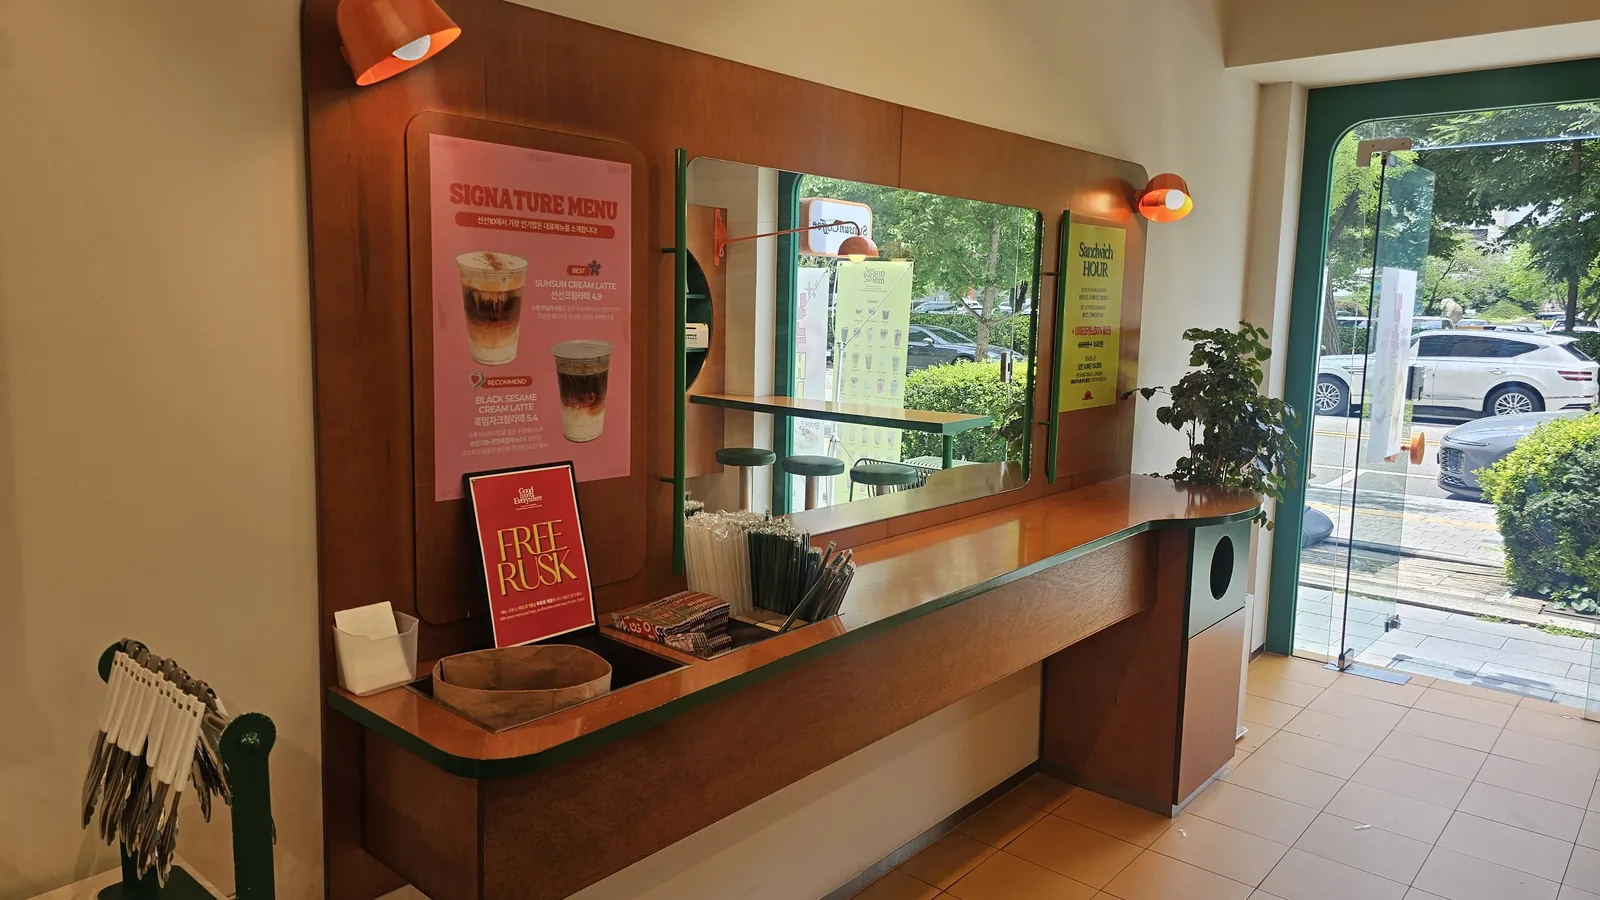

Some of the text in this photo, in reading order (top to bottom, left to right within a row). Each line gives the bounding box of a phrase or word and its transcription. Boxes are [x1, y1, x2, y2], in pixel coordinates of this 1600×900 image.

[450, 183, 618, 220] SIGNATURE MENU
[508, 219, 520, 228] 가장
[1079, 242, 1114, 260] Sandwich
[1082, 261, 1108, 277] HOUR
[535, 280, 567, 288] SUNSUN
[568, 281, 594, 289] CREAM
[551, 290, 590, 300] 선선크림라떼
[475, 393, 537, 404] BLACK SESAME
[479, 403, 534, 413] CREAM LATTE
[474, 414, 538, 426] 흑임자크림라떼 5.4
[518, 486, 534, 494] Good
[497, 519, 568, 561] FREE
[497, 549, 578, 596] RUSK
